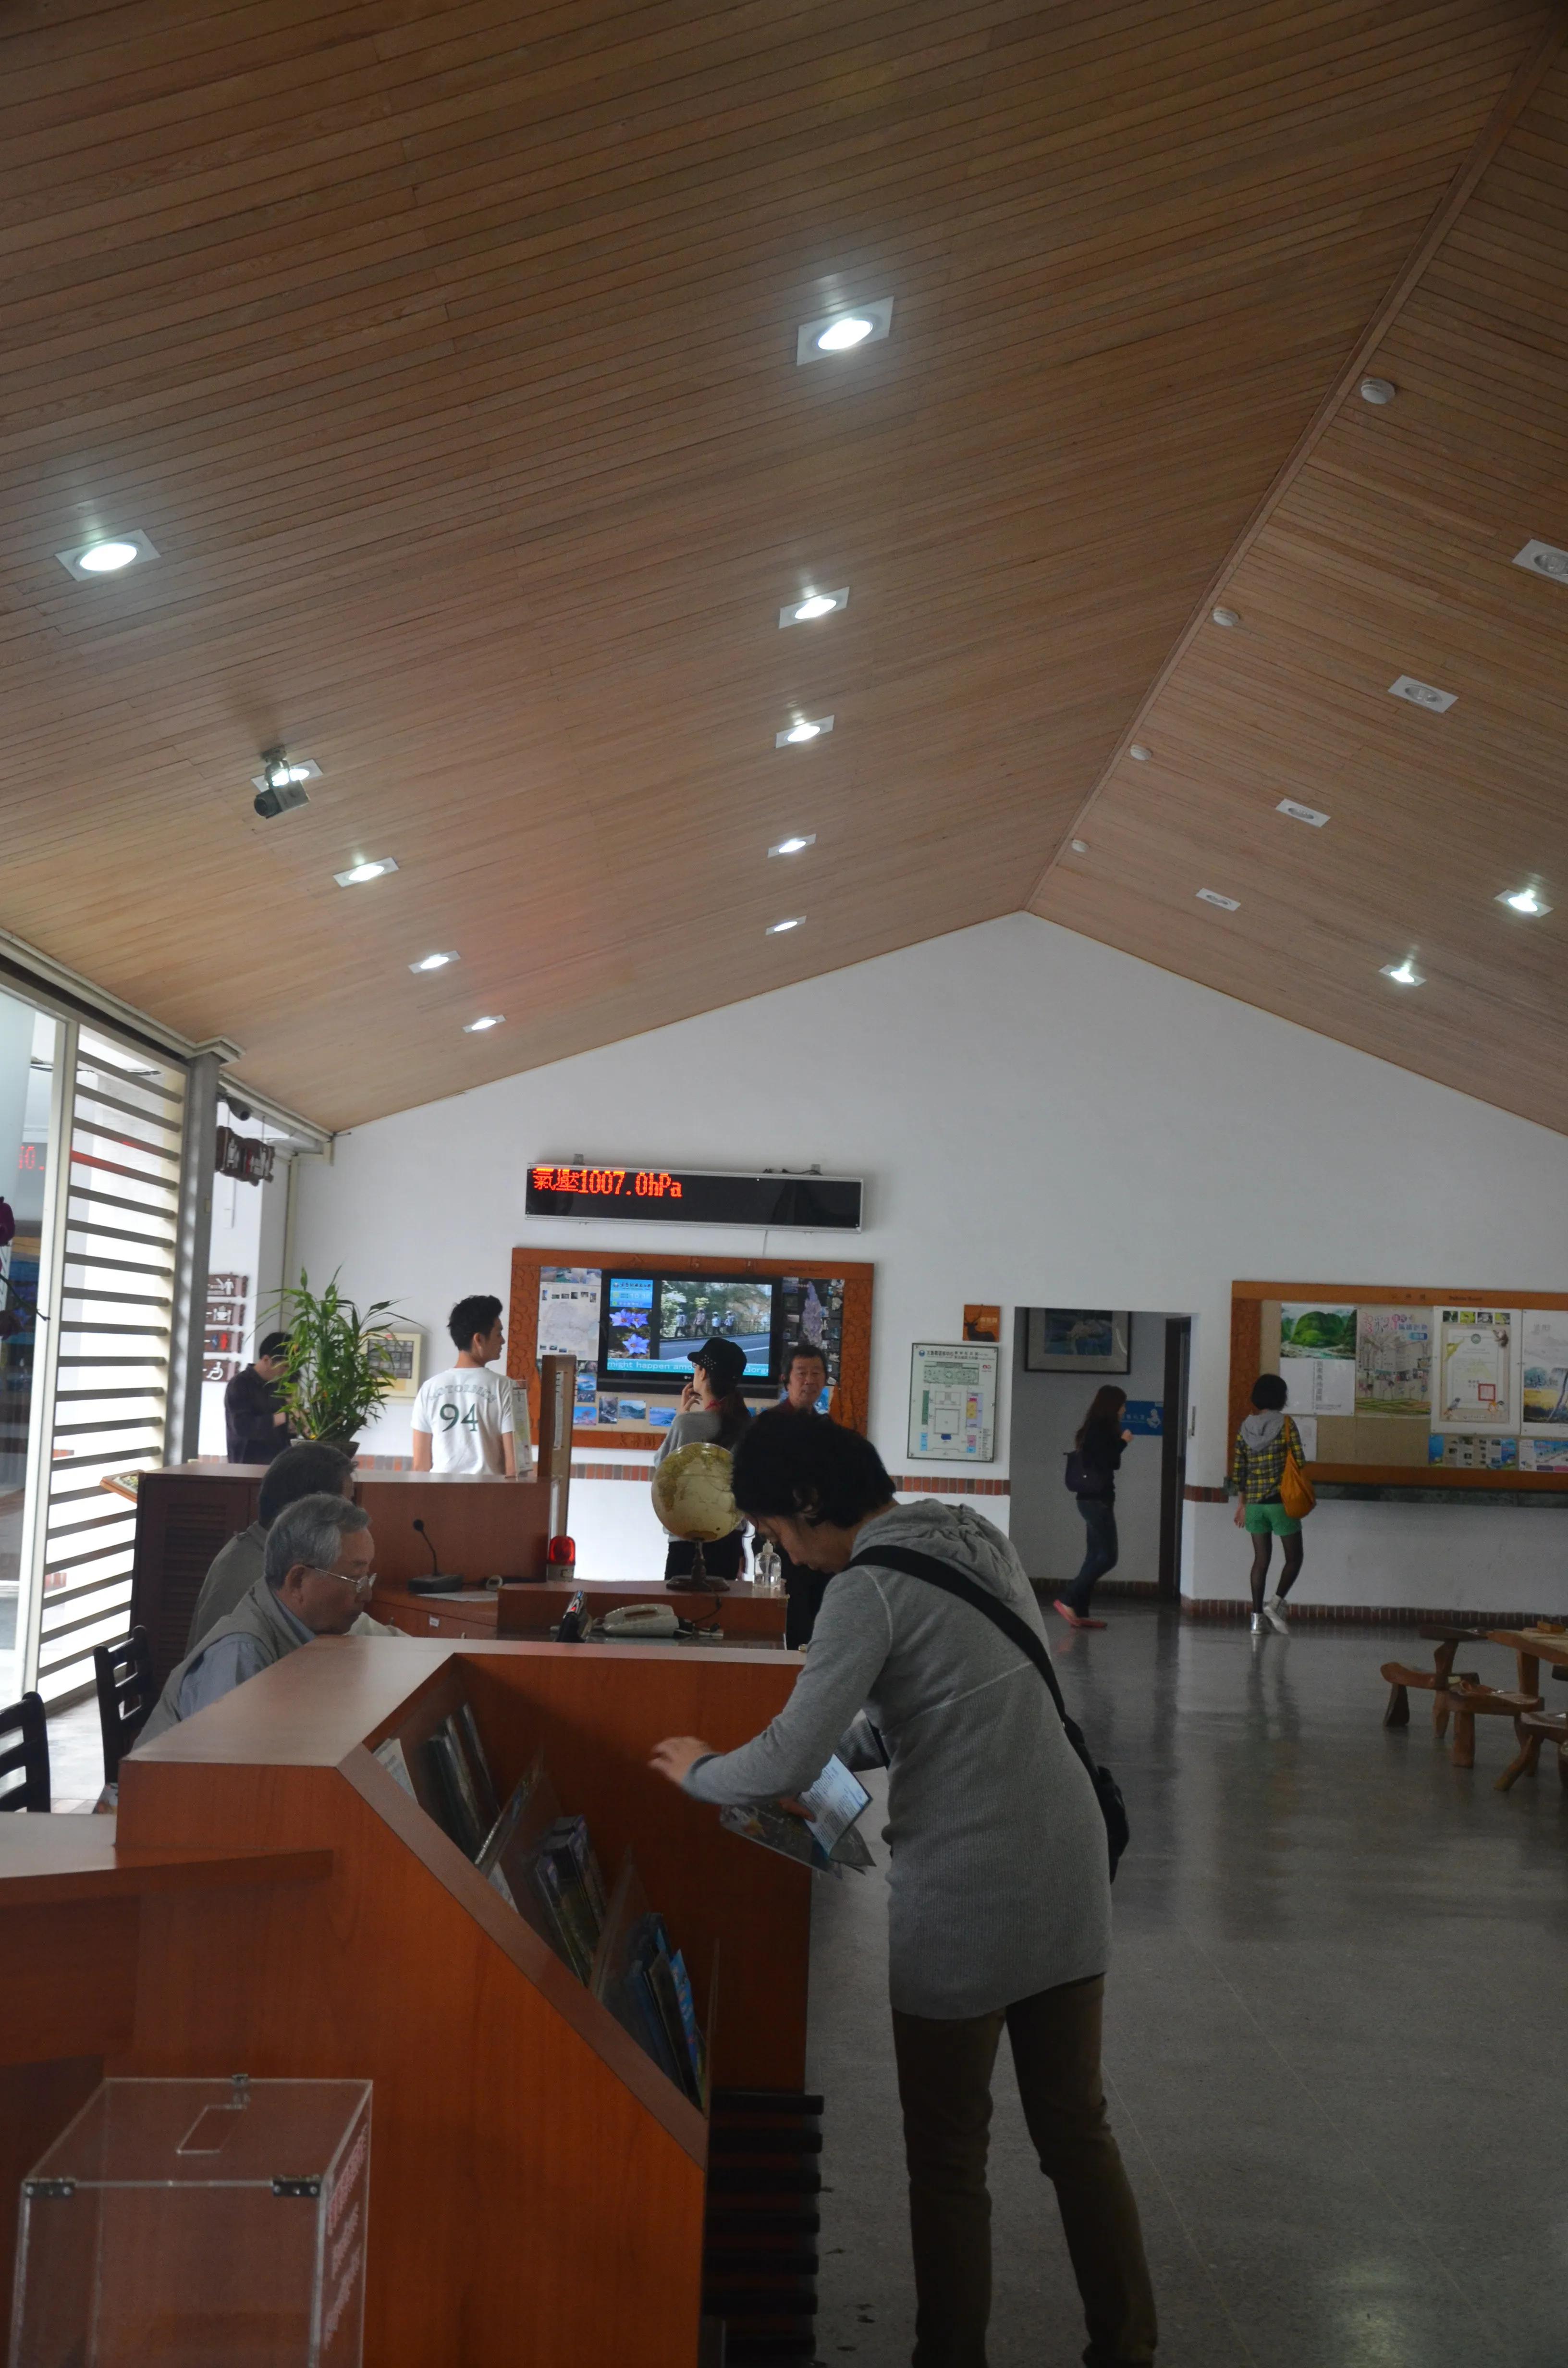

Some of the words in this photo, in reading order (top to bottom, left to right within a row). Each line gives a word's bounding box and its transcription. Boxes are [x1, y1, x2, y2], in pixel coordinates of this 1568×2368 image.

[607, 1359, 632, 1369] might
[636, 1360, 671, 1371] happen
[440, 1403, 478, 1432] 94
